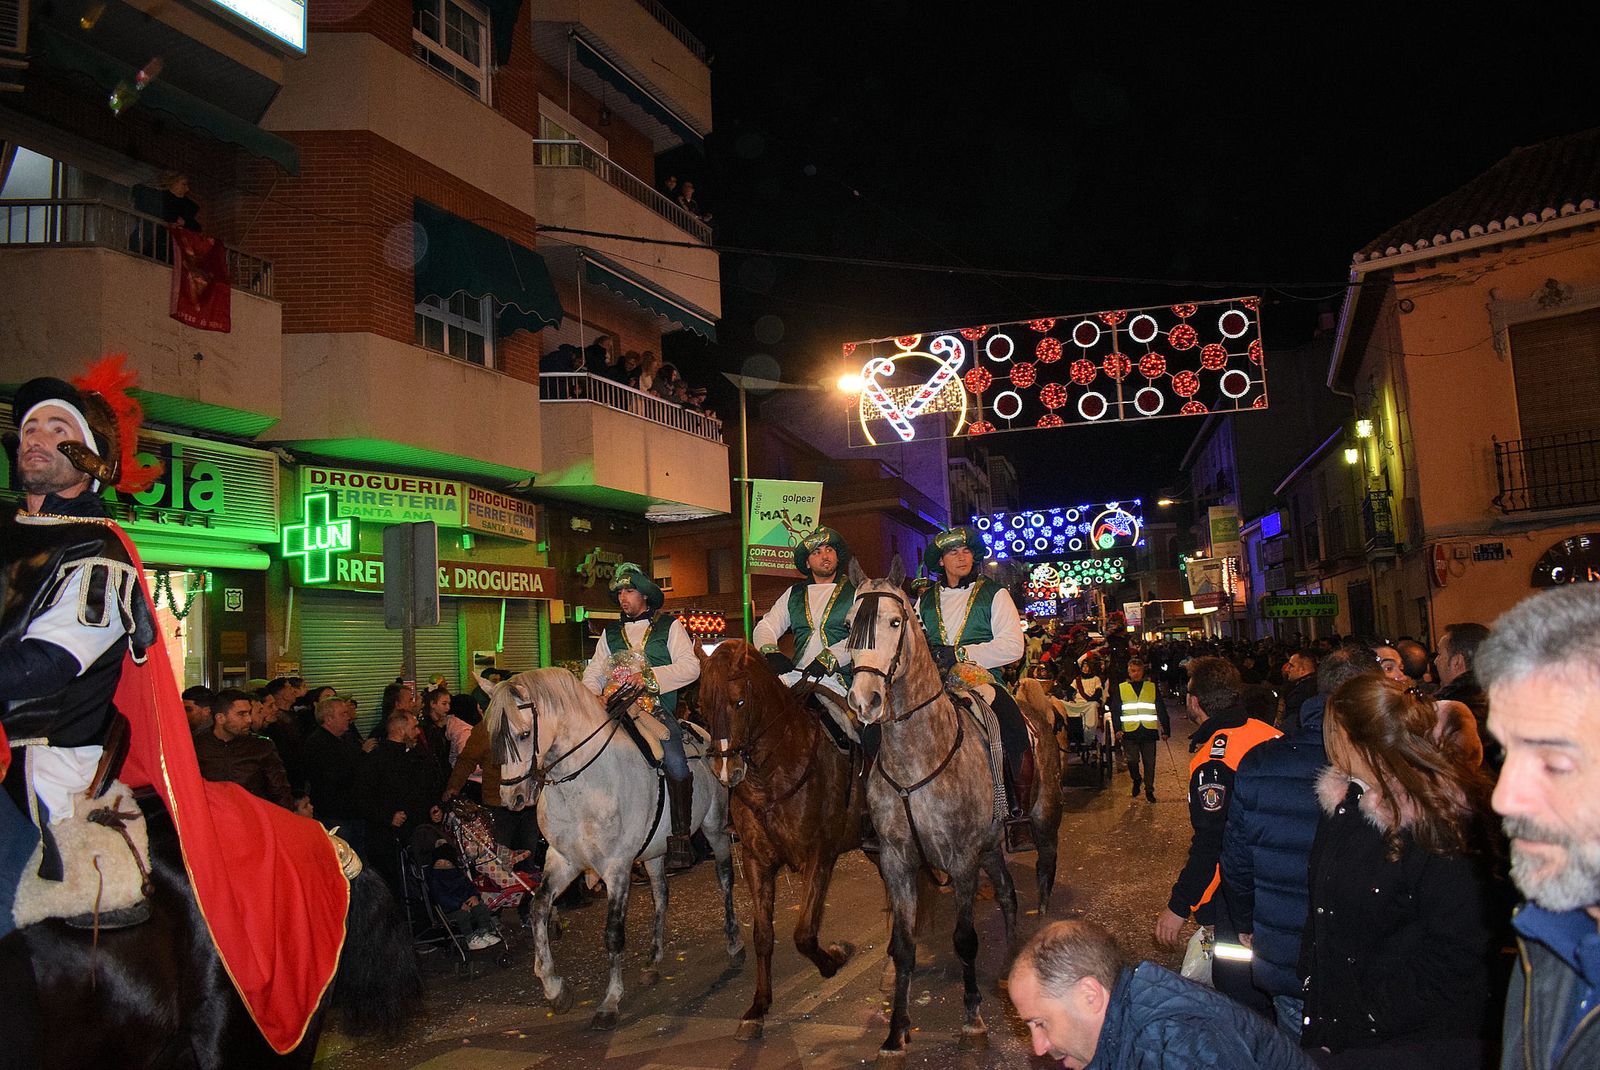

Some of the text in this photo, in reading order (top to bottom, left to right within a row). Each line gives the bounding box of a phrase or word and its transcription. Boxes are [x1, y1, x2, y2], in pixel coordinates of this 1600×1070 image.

[310, 469, 457, 496] DROGUERIA
[469, 487, 534, 517] DROGUERIA
[783, 494, 815, 504] golpear
[340, 505, 432, 520] SANTA ANA
[469, 502, 534, 529] FERRETERIA
[481, 520, 524, 537] SANTA ANA
[749, 548, 777, 557] CORTA
[454, 567, 544, 592] DROGUERIA
